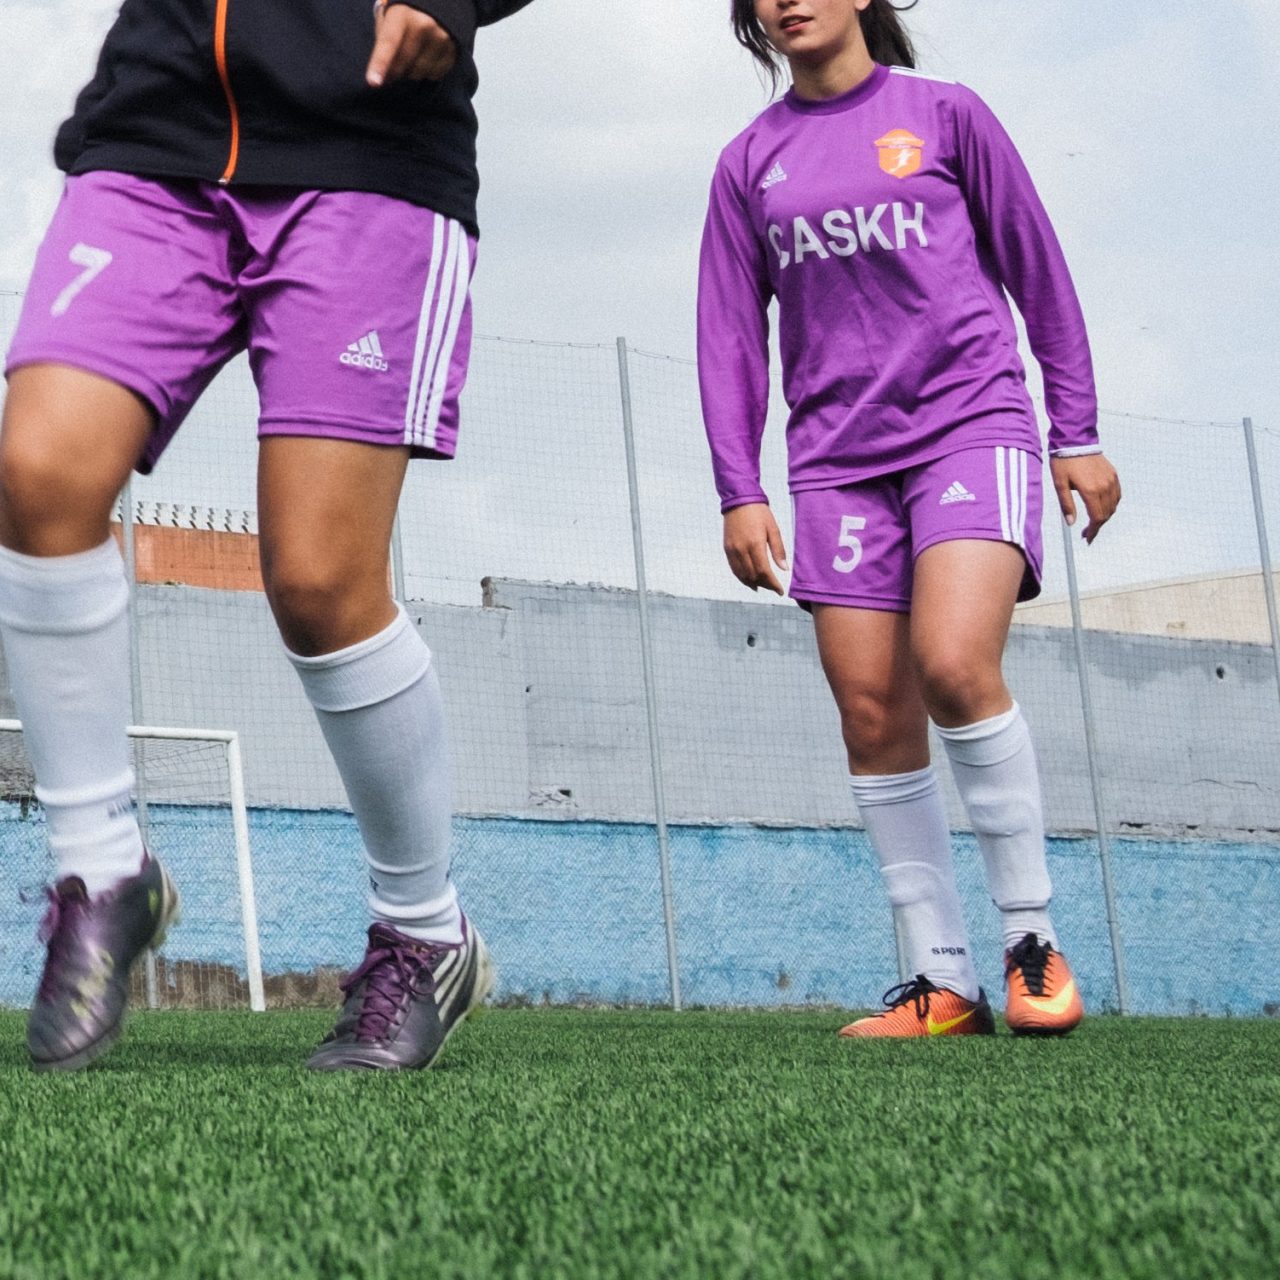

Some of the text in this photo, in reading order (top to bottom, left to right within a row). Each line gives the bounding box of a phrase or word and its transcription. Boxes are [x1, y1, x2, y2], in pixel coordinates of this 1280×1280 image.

[50, 242, 113, 318] 7
[340, 352, 388, 371] adidas
[832, 515, 867, 574] 5
